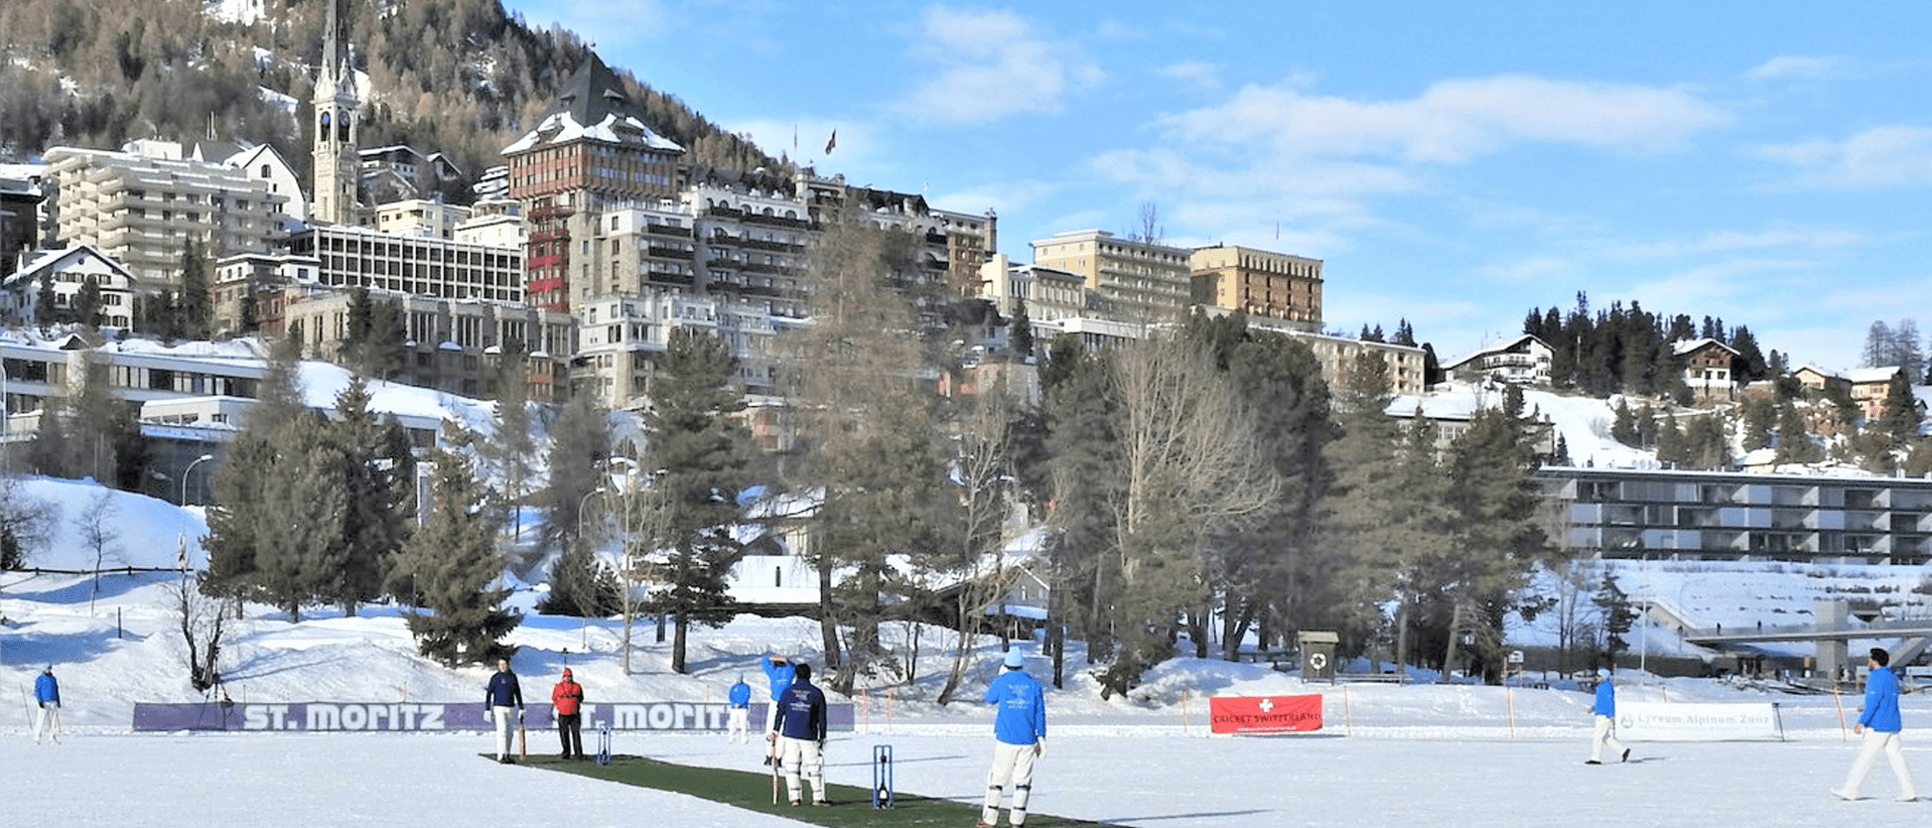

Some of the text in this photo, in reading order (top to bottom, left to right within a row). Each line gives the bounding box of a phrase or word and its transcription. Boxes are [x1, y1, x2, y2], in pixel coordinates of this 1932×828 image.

[243, 704, 298, 730] ST.
[1638, 714, 1770, 725] Lyceum Alpinum Zuoz
